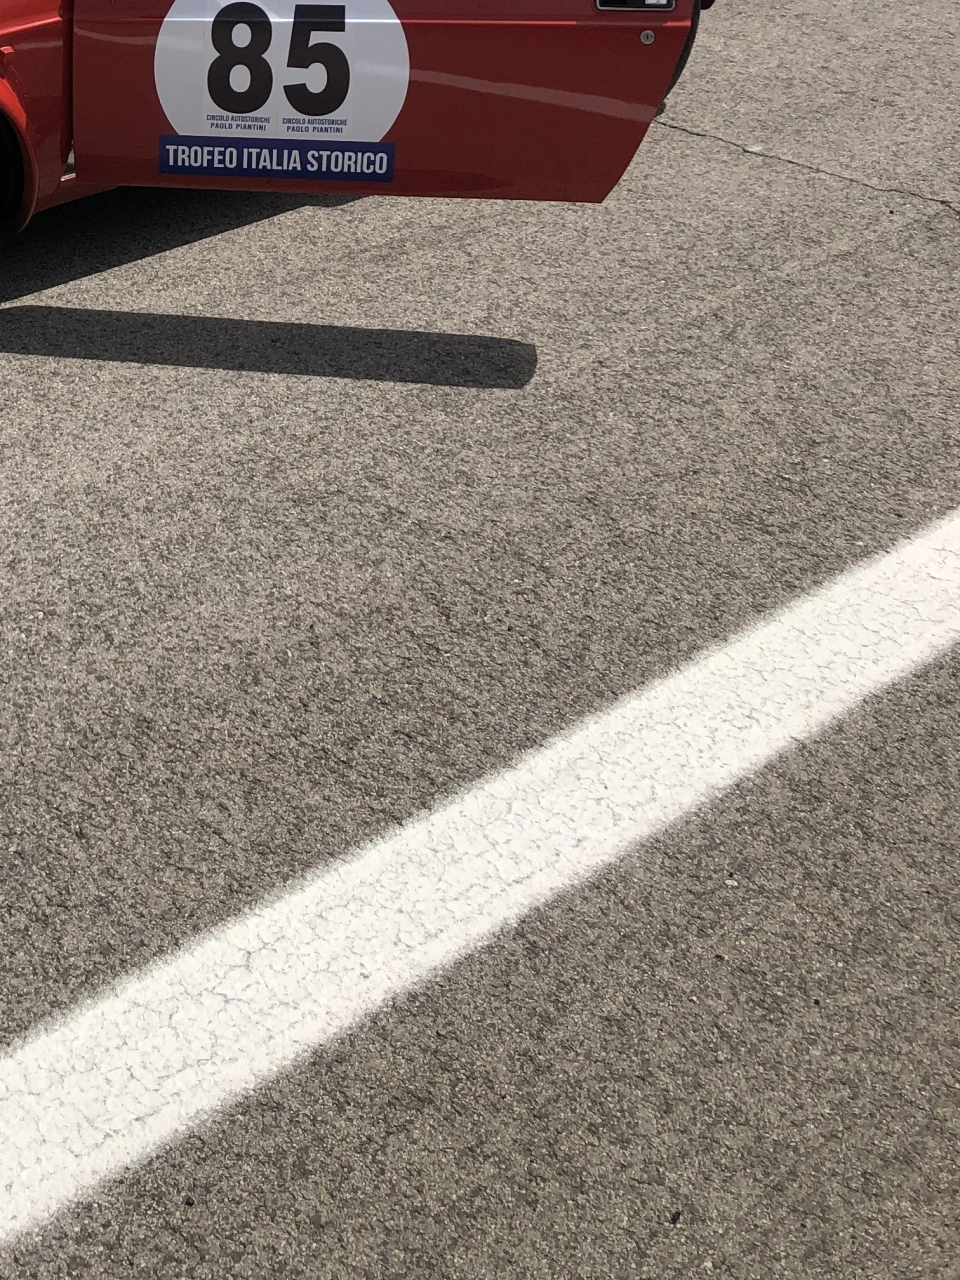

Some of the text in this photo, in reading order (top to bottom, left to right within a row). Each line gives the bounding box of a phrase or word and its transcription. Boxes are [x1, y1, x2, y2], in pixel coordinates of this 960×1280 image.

[207, 1, 350, 117] 85
[206, 114, 271, 124] CIRCOLO AUTOSTORICHE
[282, 117, 348, 126] CIRCOLO AUTOSTORICHE
[210, 122, 267, 132] PAOLO PIANTINI
[286, 125, 343, 134] PAOLO PIANTINI
[165, 145, 388, 174] TROFEO ITALIA STORICO
